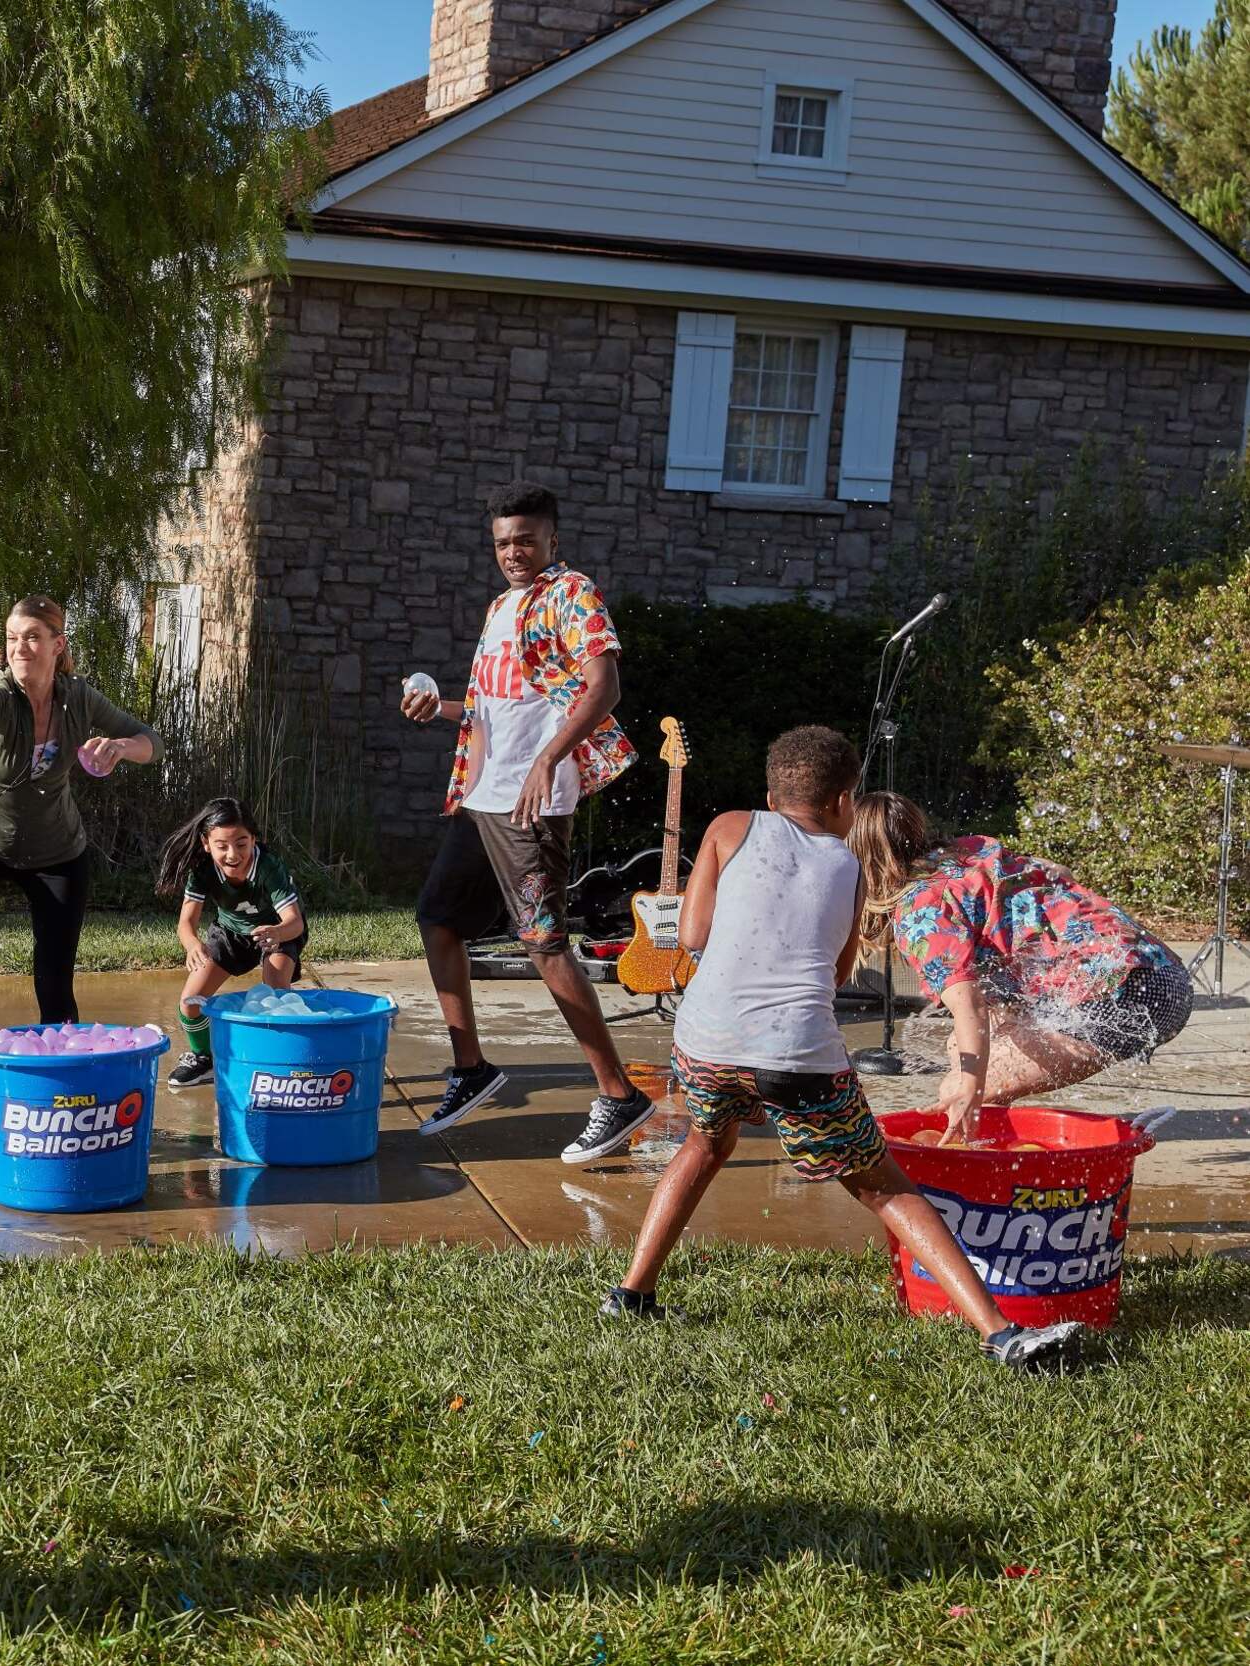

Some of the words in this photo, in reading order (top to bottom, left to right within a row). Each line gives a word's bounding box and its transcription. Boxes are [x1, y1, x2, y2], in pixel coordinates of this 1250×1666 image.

[53, 1095, 96, 1109] ZURU
[256, 1094, 345, 1109] Balloons
[7, 1126, 134, 1154] Balloons
[1012, 1187, 1087, 1210] ZURU
[966, 1241, 1125, 1287] alloons
